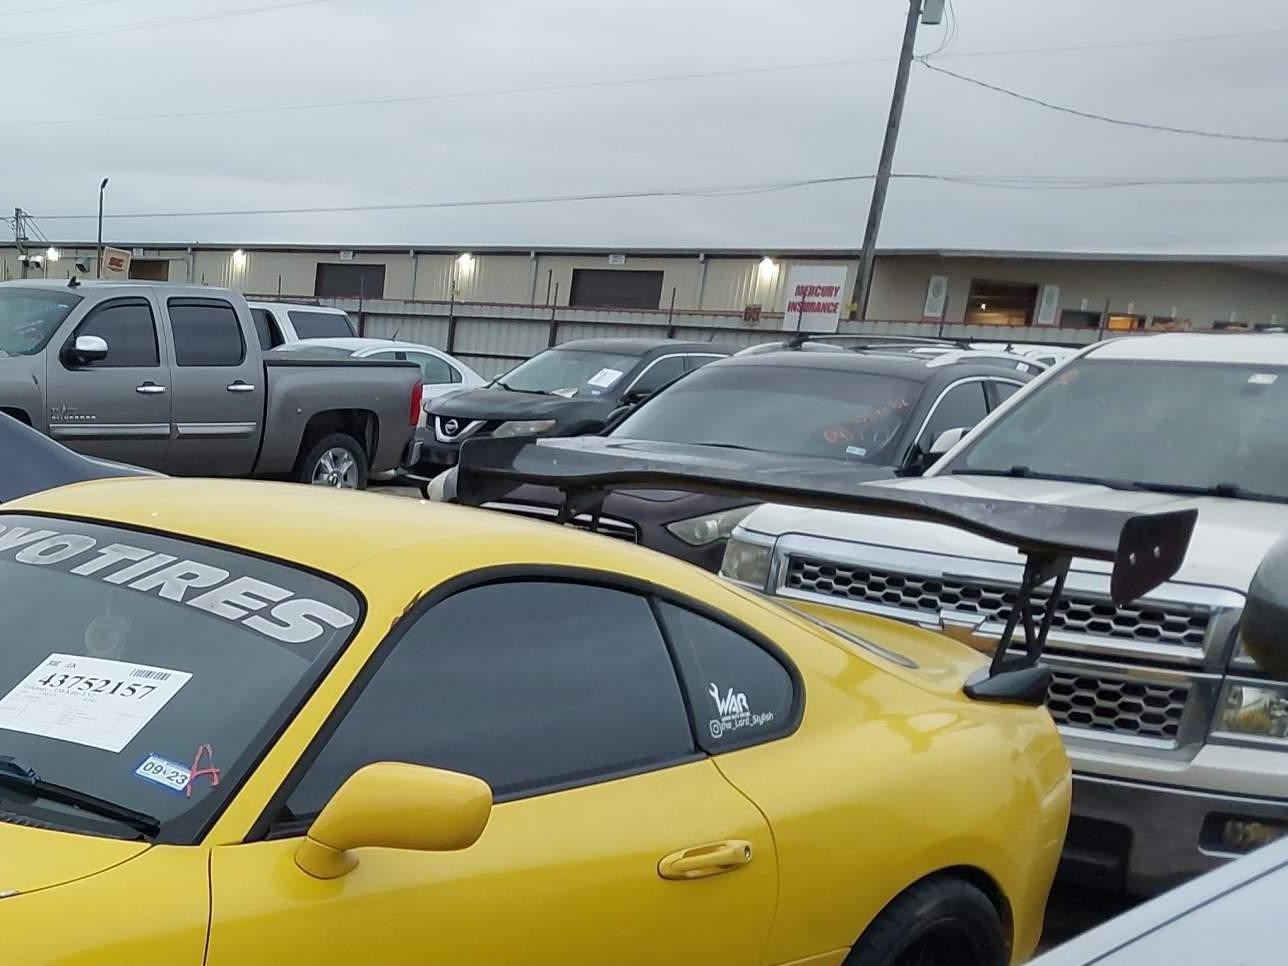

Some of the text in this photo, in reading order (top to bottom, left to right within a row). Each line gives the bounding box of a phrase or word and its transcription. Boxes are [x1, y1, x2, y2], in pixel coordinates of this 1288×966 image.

[795, 284, 840, 297] MERCURY
[787, 301, 840, 313] INSURANCE
[69, 543, 354, 643] TIRES
[38, 672, 158, 700] 43752157
[708, 683, 749, 717] WAR
[143, 761, 188, 785] 09 23
